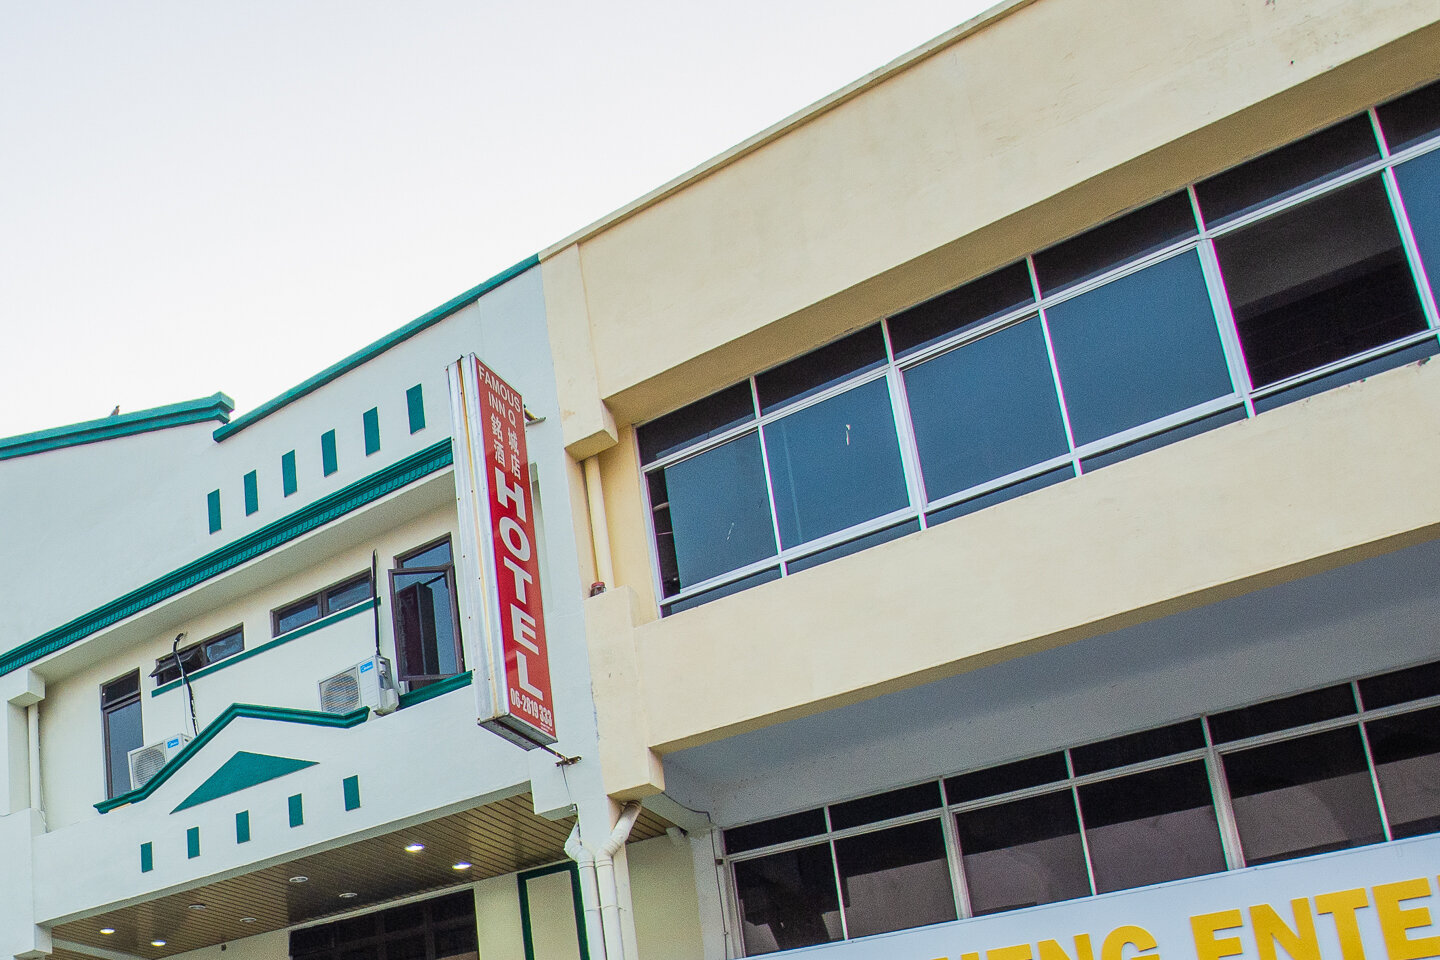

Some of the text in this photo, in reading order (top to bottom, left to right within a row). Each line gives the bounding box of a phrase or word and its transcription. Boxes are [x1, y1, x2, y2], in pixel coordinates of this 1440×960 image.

[478, 365, 521, 413] FAMOUS
[488, 391, 517, 428] INN Q
[495, 467, 543, 701] HOTEL
[510, 687, 553, 727] 06-2819 333
